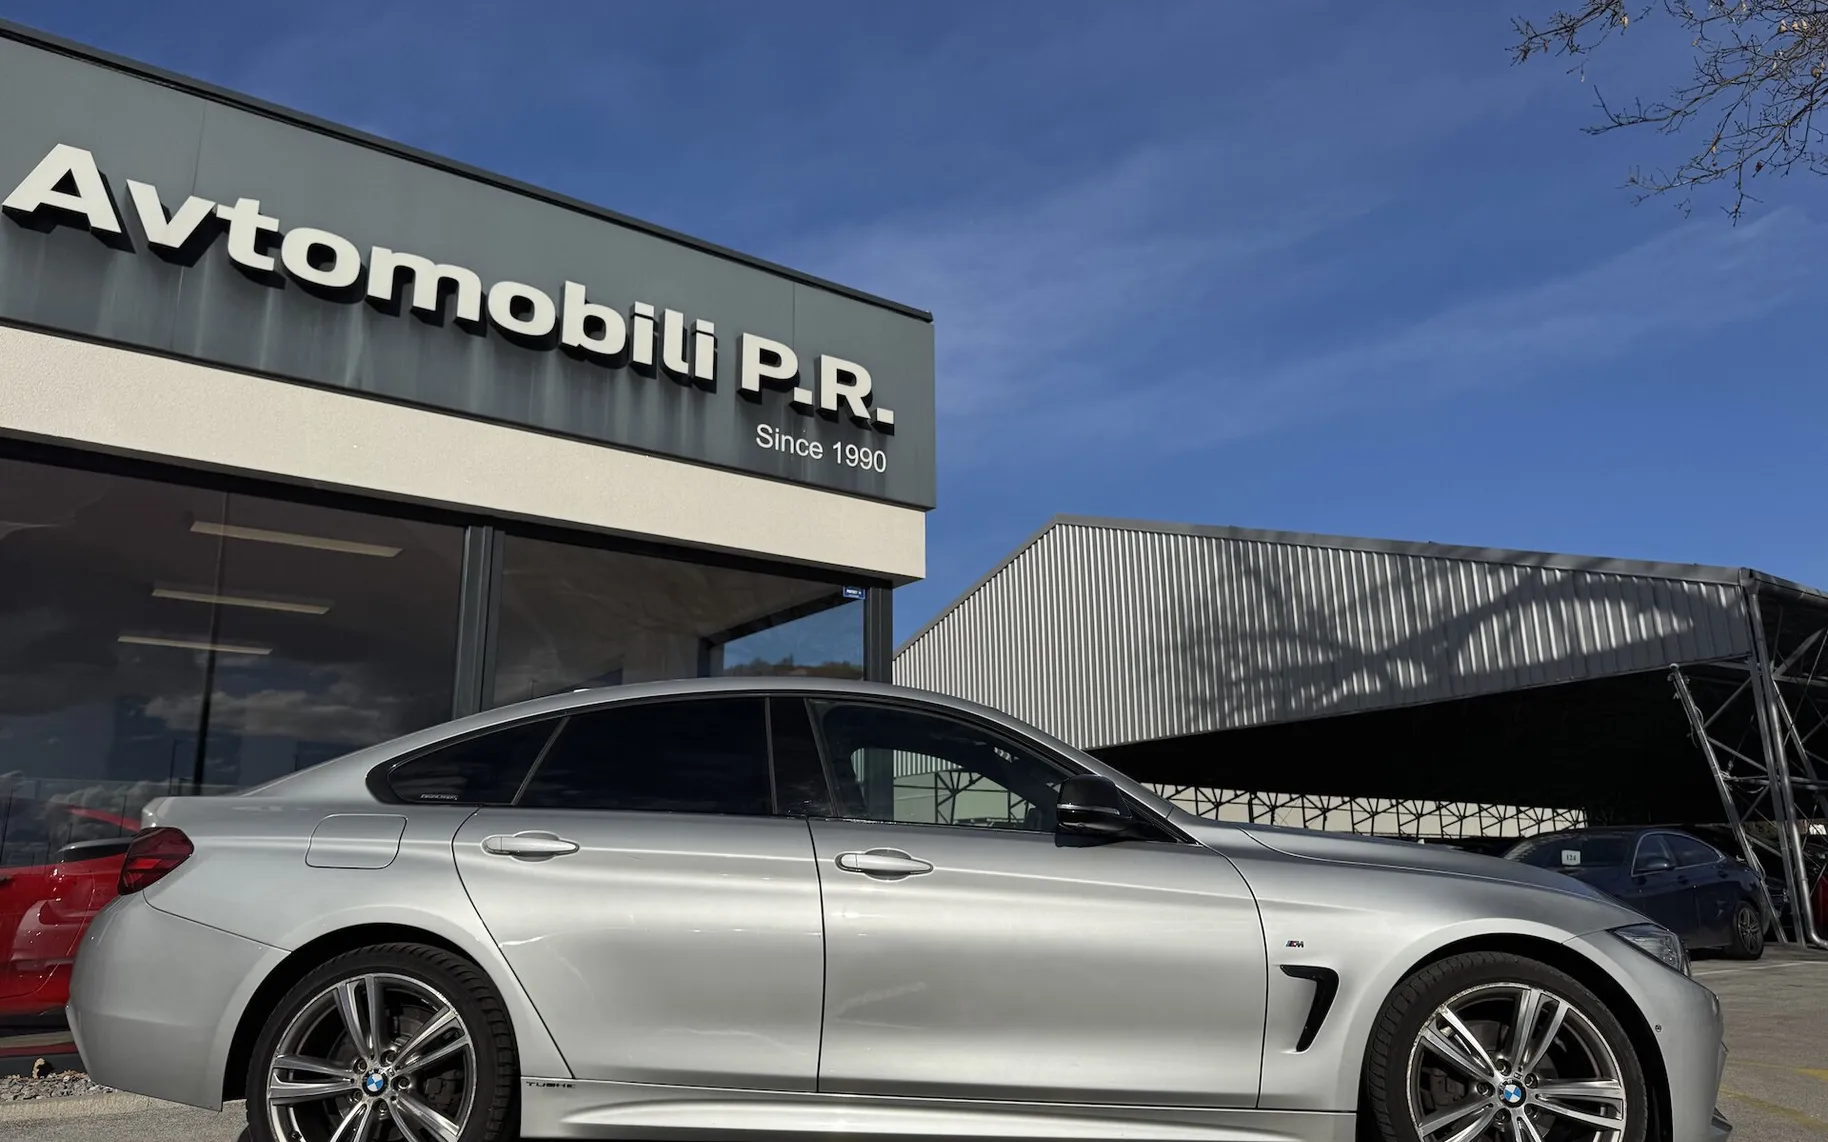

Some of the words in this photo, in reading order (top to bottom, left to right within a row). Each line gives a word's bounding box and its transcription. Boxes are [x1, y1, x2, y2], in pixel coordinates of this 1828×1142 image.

[3, 143, 716, 382] Avtomobili
[740, 332, 895, 425] P.R.
[756, 423, 824, 460] Since
[832, 441, 887, 474] 1990
